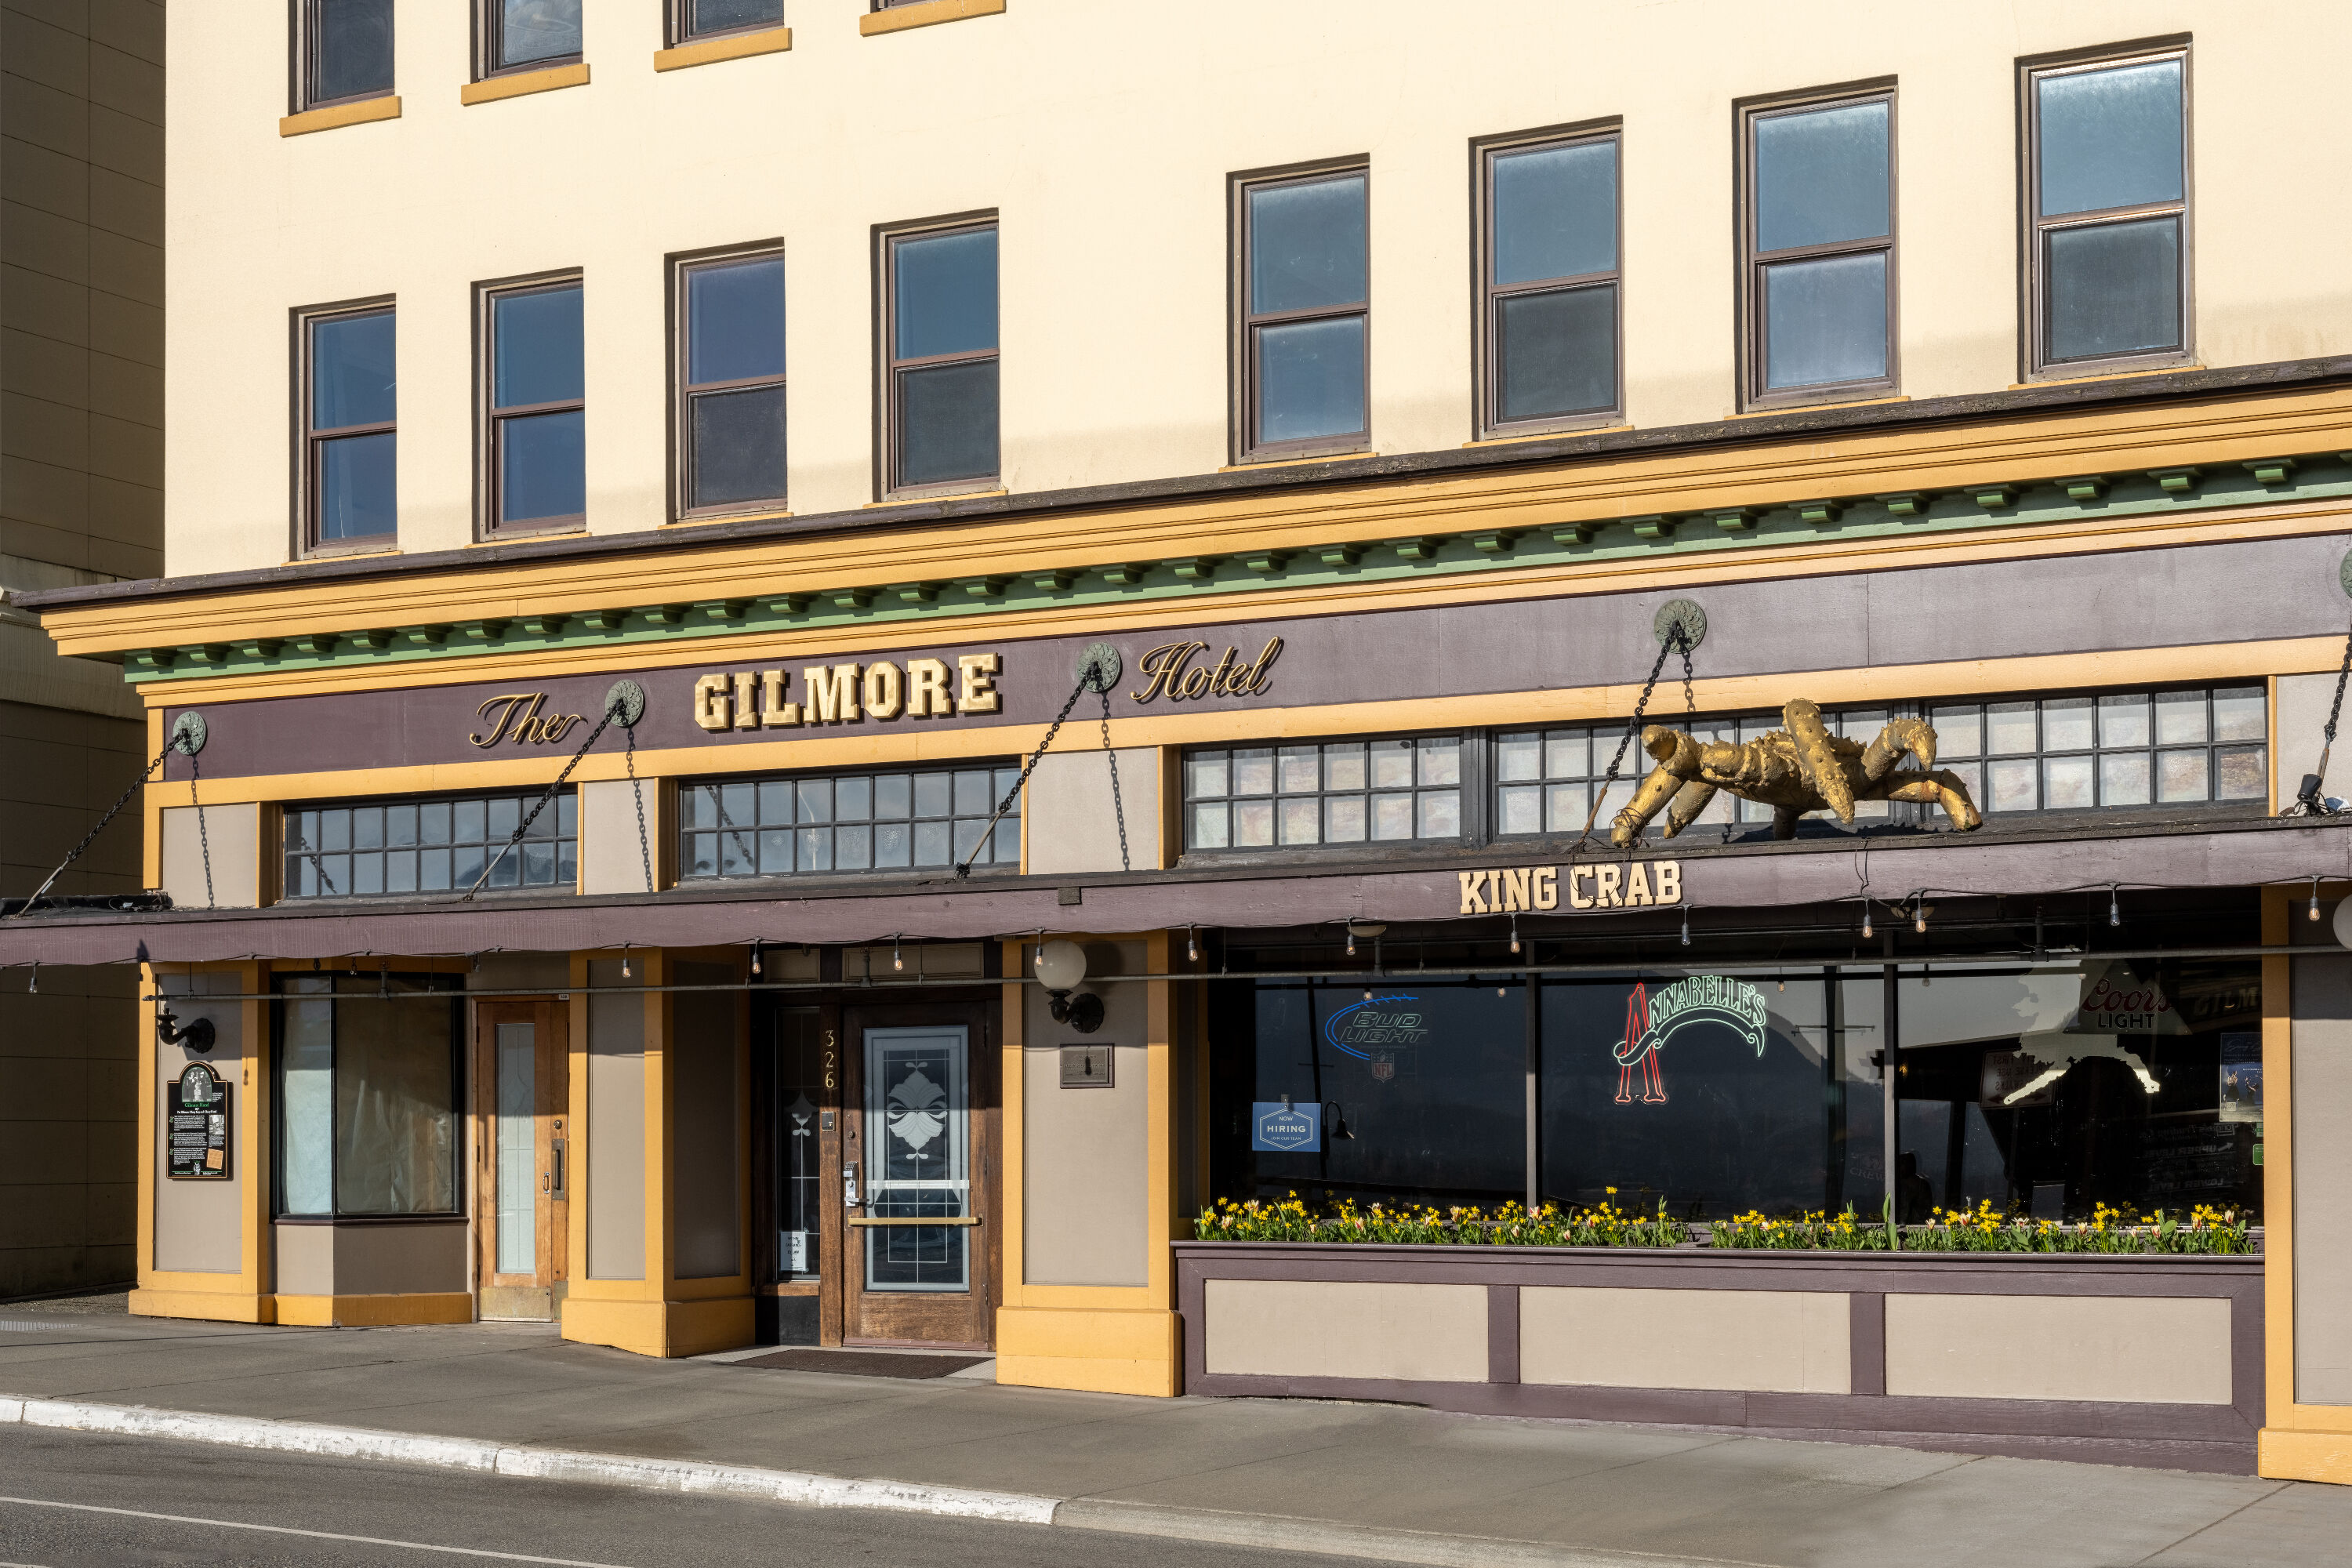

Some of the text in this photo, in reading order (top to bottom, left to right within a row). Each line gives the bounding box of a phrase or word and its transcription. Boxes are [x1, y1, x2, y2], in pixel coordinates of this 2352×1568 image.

[469, 636, 1280, 746] The GILMORE Hotel
[1458, 860, 1683, 914] KING CRAB
[2082, 978, 2171, 1011] Coors
[1352, 1011, 1422, 1028] BUD
[2098, 1013, 2155, 1029] LIGHT
[1339, 1026, 1429, 1044] LIGHT
[825, 1029, 834, 1088] 326
[1374, 1063, 1393, 1077] NFL
